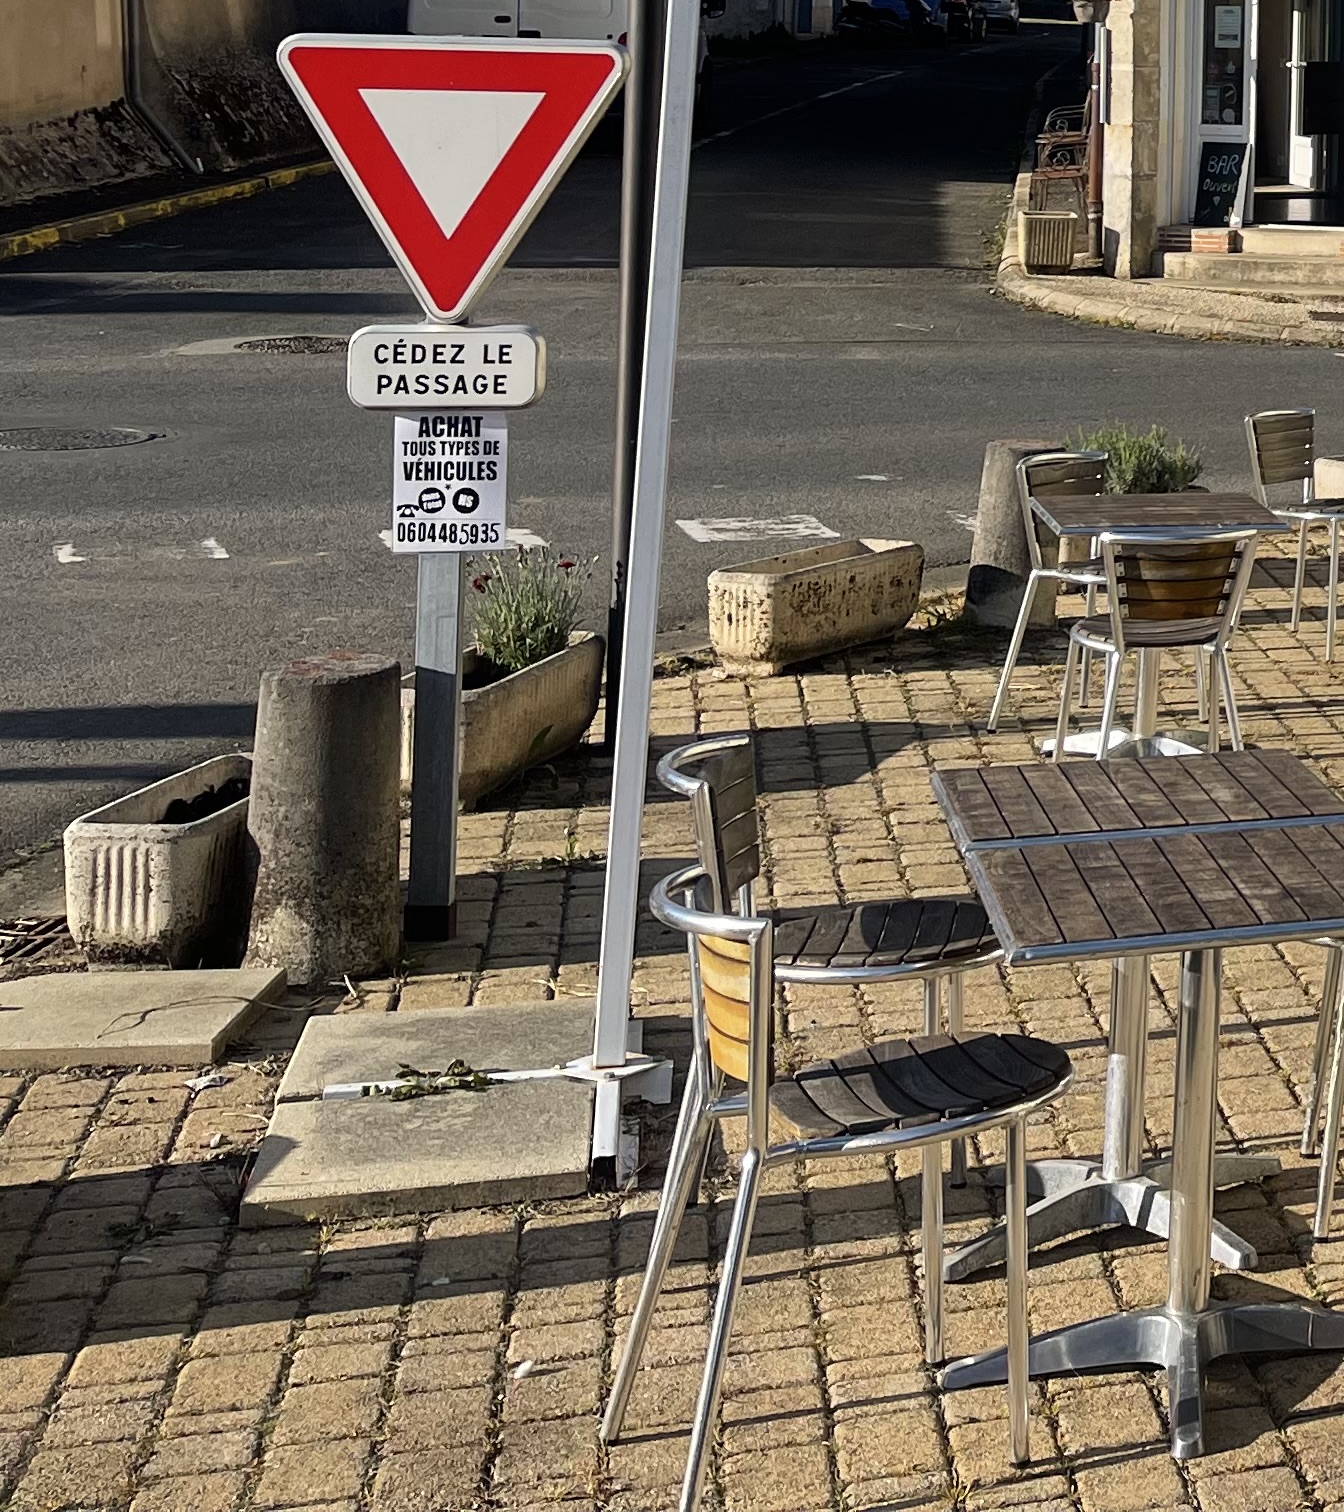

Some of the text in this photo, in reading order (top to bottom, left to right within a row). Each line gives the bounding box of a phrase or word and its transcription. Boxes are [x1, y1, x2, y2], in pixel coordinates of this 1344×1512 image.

[1207, 154, 1239, 175] BAR
[1203, 178, 1238, 193] Ouvert
[374, 338, 513, 364] CÉDEZ LE
[377, 374, 508, 395] PASSAGE
[418, 415, 484, 438] ACHAT
[402, 440, 500, 457] TOUS TYPES DE
[402, 457, 498, 482] VÉHICULES
[397, 522, 501, 545] 0604485935
